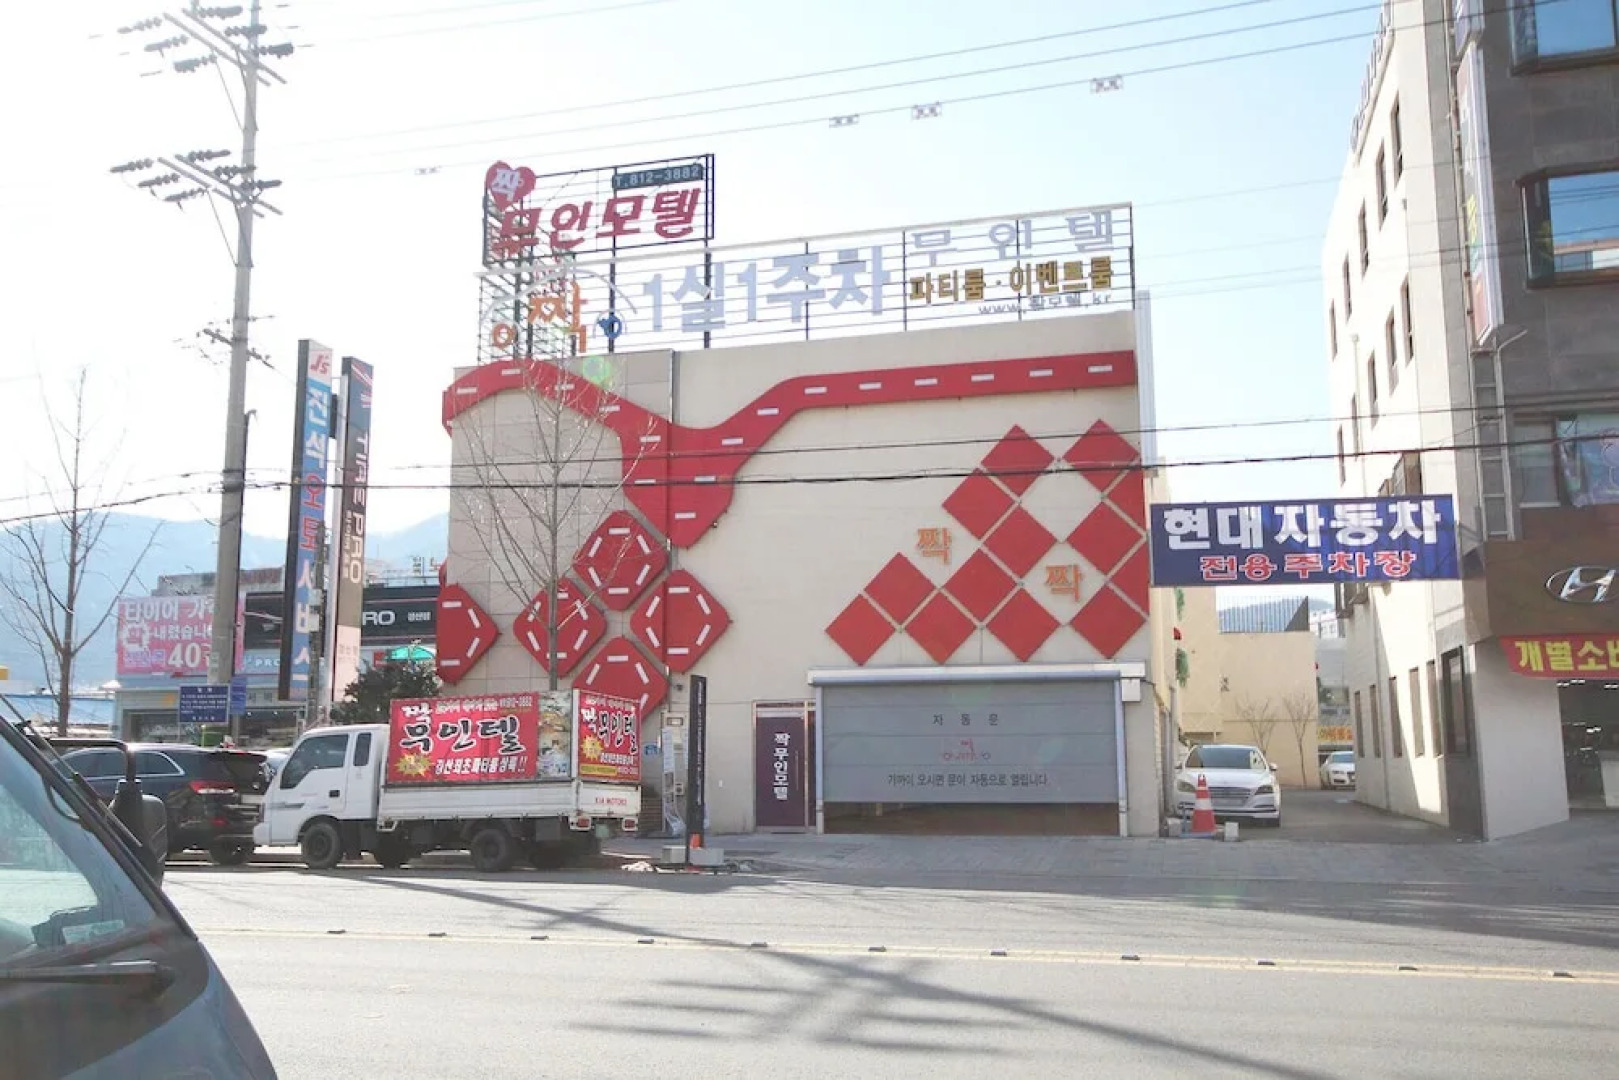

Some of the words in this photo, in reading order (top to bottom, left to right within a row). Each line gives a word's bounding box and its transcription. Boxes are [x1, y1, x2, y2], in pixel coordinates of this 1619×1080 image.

[492, 168, 524, 201] 짝
[496, 188, 701, 254] 무인모텔
[917, 528, 952, 565] 짝
[1044, 564, 1083, 602] 짝
